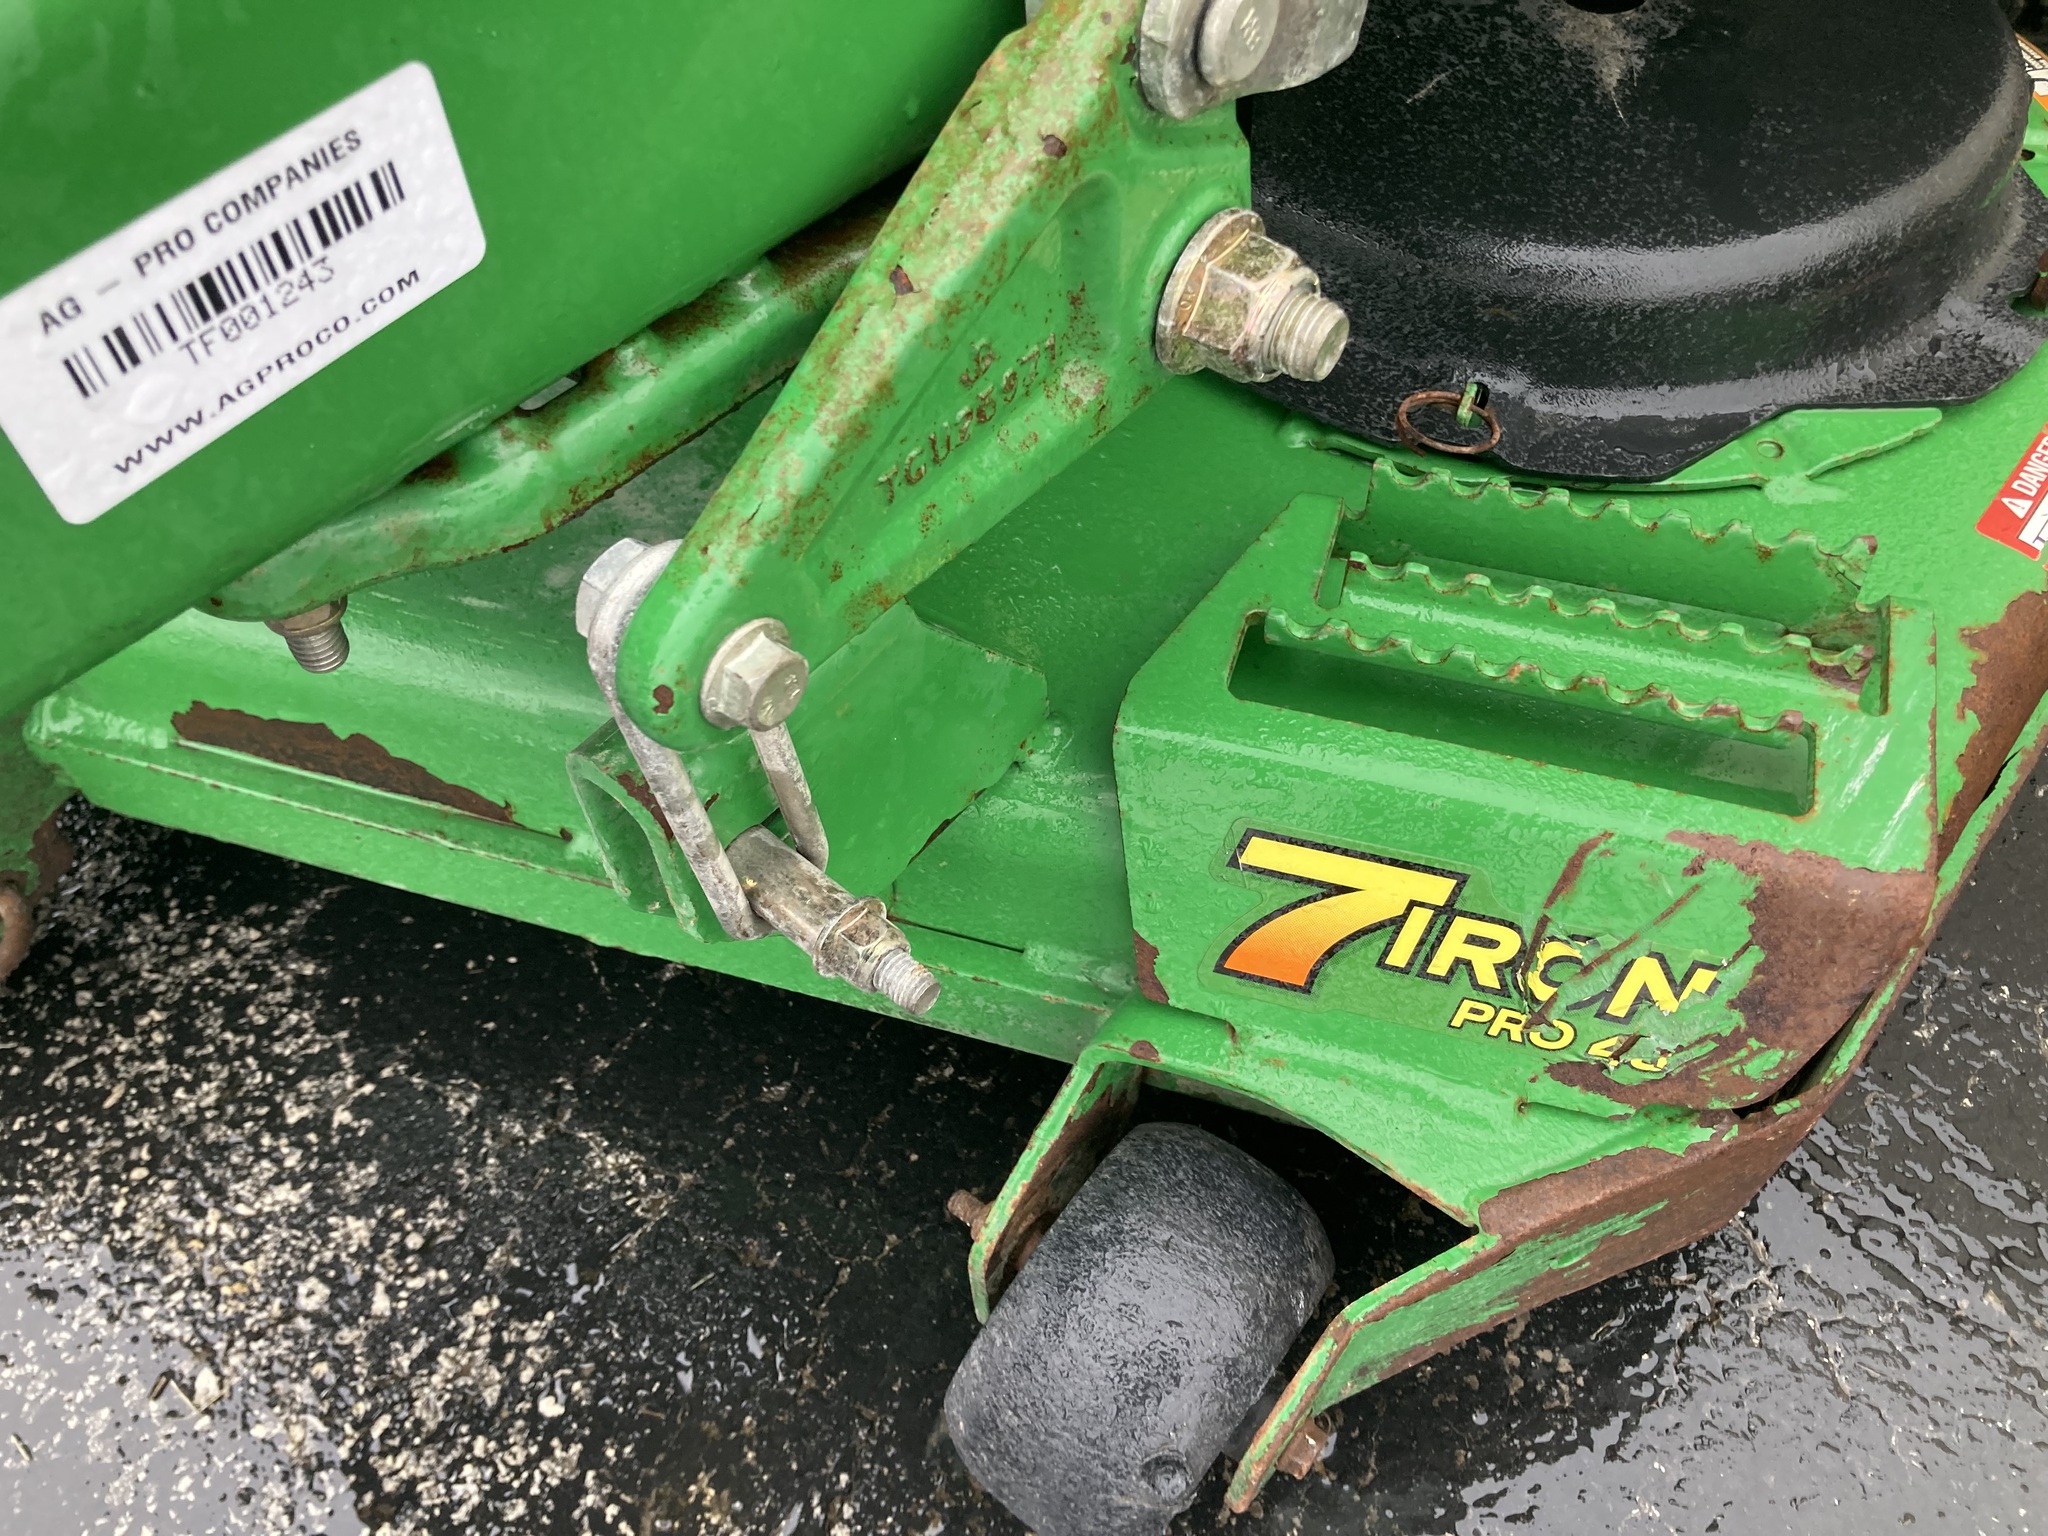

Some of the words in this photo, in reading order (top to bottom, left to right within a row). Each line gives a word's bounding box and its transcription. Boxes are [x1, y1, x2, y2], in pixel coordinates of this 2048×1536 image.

[38, 296, 82, 335] AG
[133, 227, 196, 278] PRO
[203, 129, 362, 236] COMPANIES
[178, 255, 336, 366] TF001243
[113, 269, 421, 475] WWW.AGPROCO.COM
[2011, 435, 2048, 497] DANGE
[1448, 998, 1578, 1052] PRO
